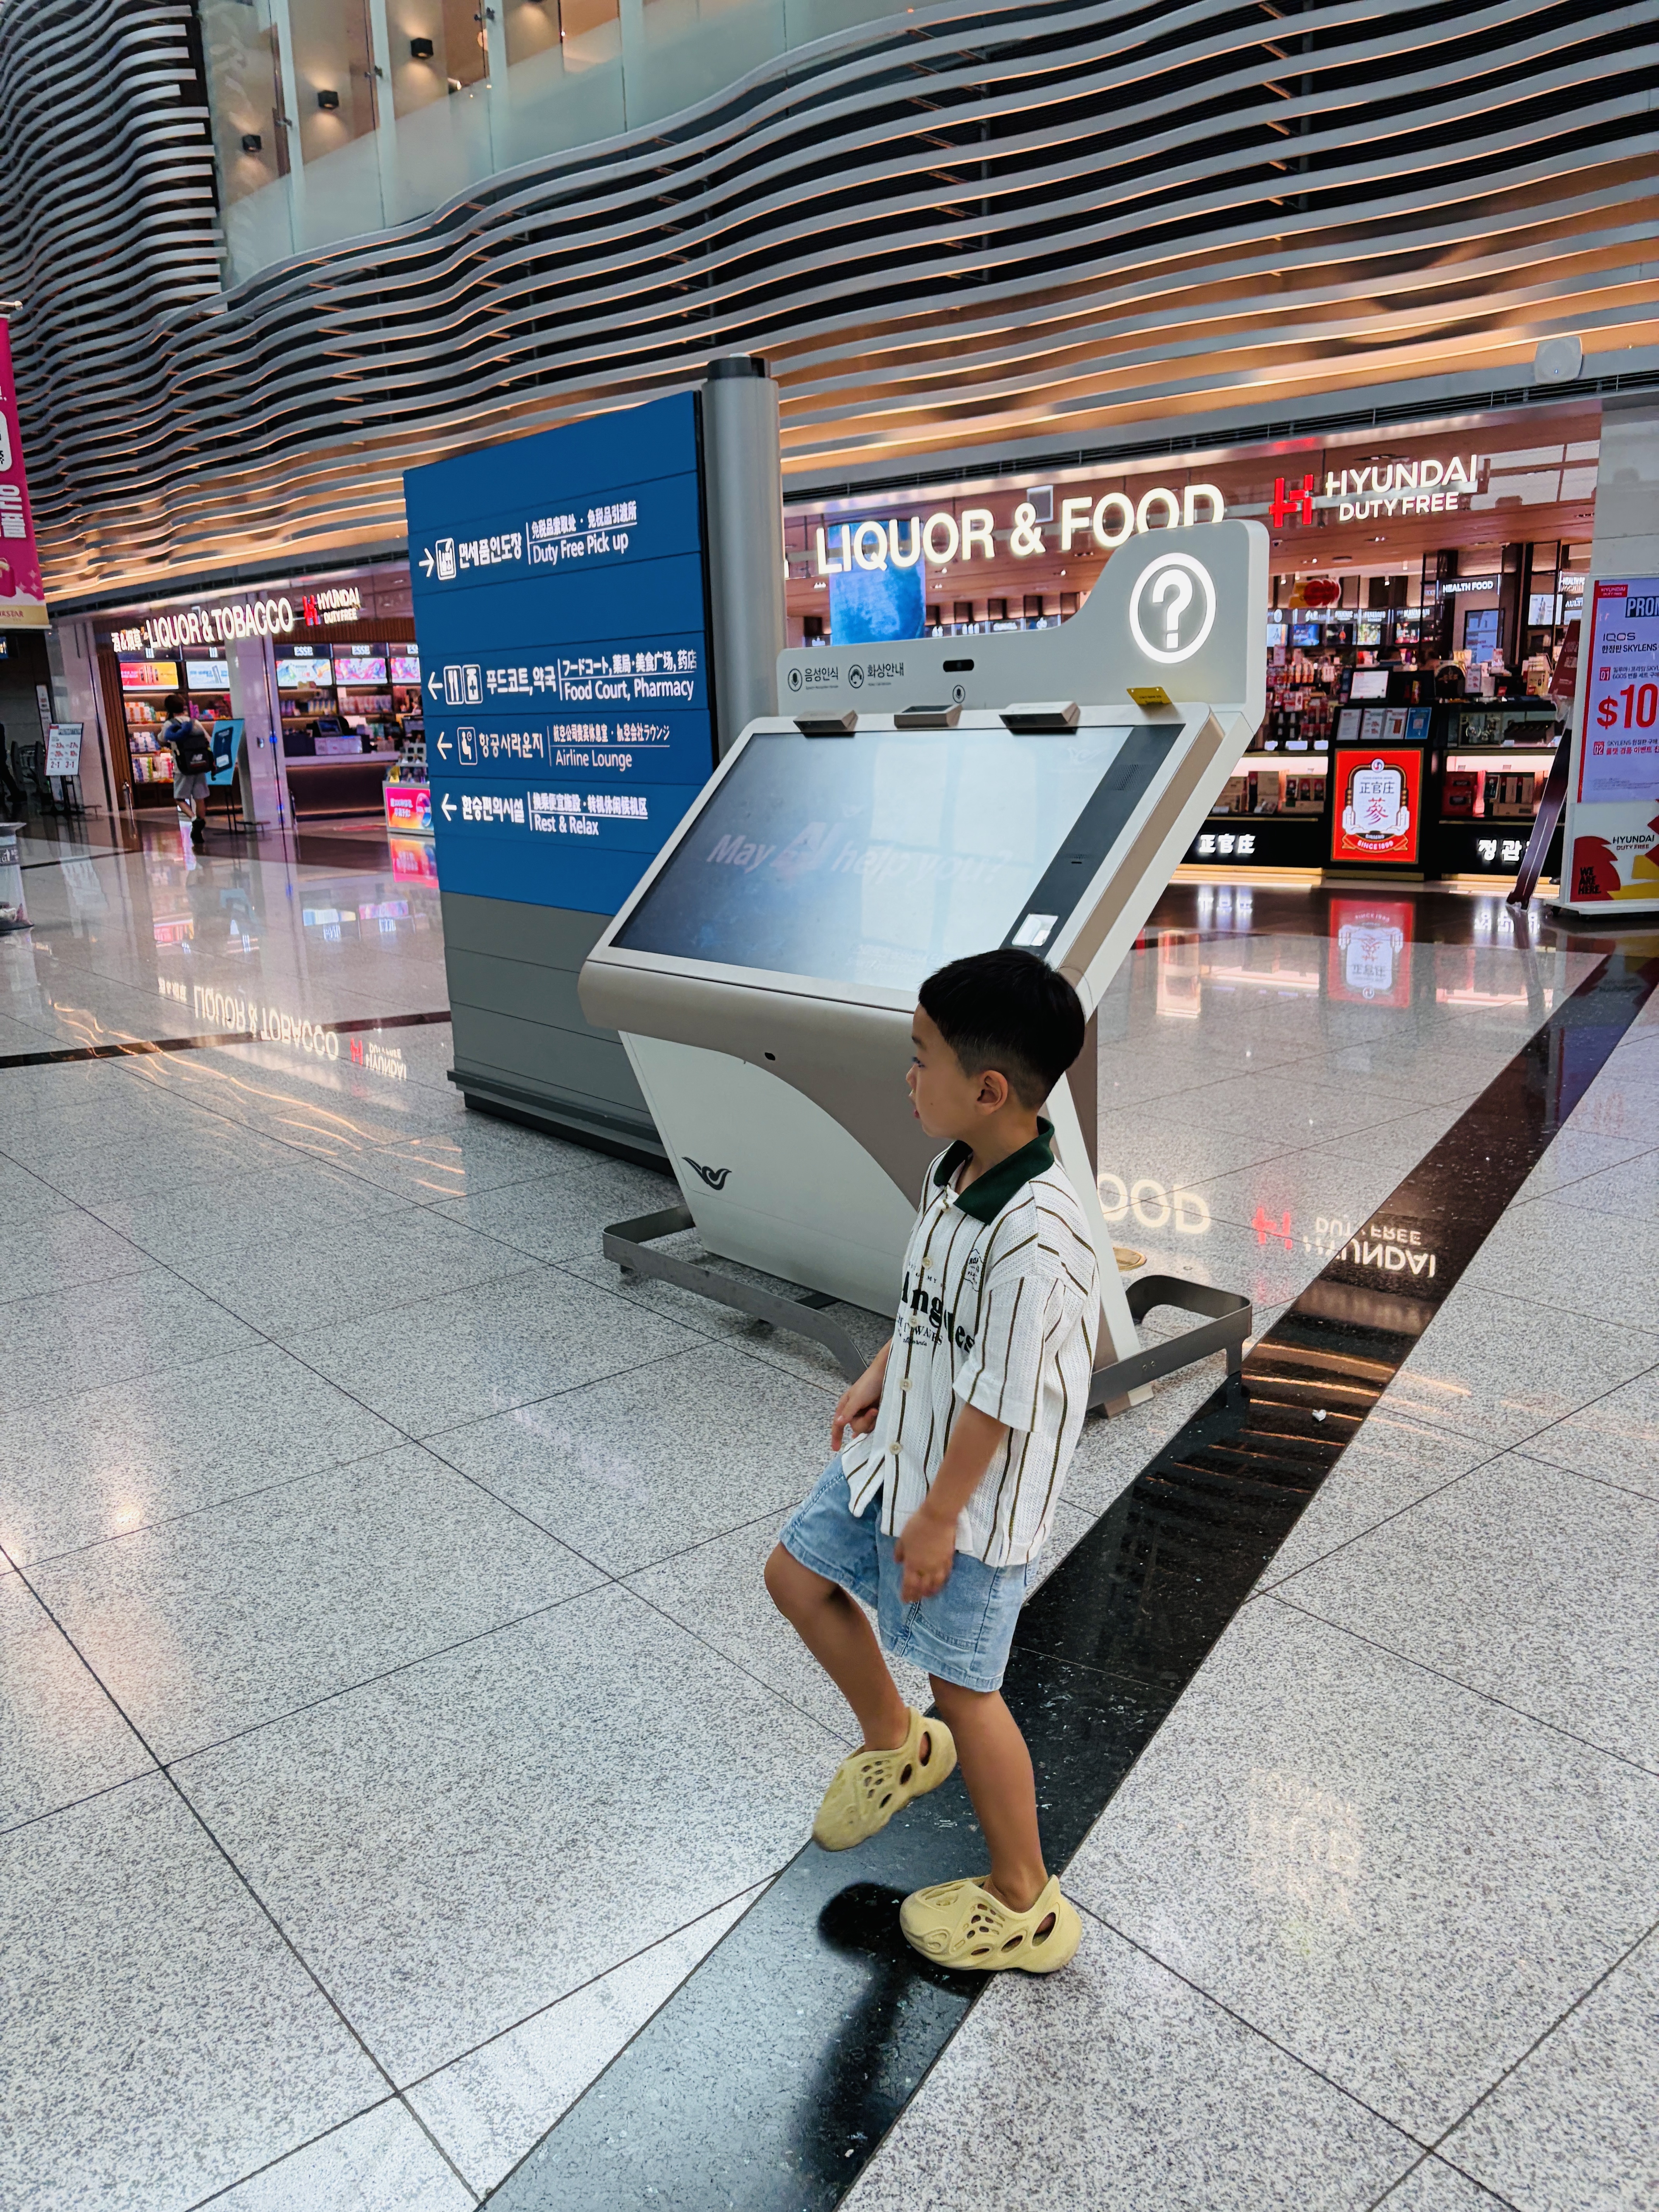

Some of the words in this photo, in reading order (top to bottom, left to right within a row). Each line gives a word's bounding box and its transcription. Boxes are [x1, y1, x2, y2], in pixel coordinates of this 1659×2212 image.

[1326, 455, 1477, 498] HYUNDAI
[1339, 498, 1398, 521] DUTY
[1401, 491, 1459, 515] FREE
[816, 508, 995, 575] LIQUOR
[1010, 502, 1046, 556] &
[1061, 483, 1225, 551] FOOD
[458, 532, 522, 569] 면세품인도장
[533, 543, 558, 566] Duty
[560, 539, 584, 559] Free
[587, 531, 610, 555] Pick
[612, 532, 629, 554] up
[1443, 582, 1471, 593] HEALTH
[1472, 580, 1494, 591] FOOD
[316, 587, 360, 610] HYUNDAI
[146, 613, 201, 649] LIQUOR
[201, 610, 215, 642] &
[211, 597, 294, 640] TOBACCO
[323, 610, 340, 624] DUTY
[340, 608, 358, 621] FREE
[1603, 632, 1636, 642] IQOS
[1623, 643, 1657, 652] SKYLENS
[294, 646, 313, 656] ESSE
[351, 645, 371, 655] ESSE
[804, 666, 839, 682] 음성인식
[867, 662, 905, 678] 화상안내
[564, 680, 592, 701] Food
[595, 680, 631, 701] Court,
[634, 676, 695, 702] Pharmacy
[479, 732, 544, 759] 항공사라운지
[556, 749, 589, 767] Airline
[592, 749, 632, 772] Lounge
[1359, 781, 1395, 794] 正官庄
[462, 795, 525, 824] 환승편의시설
[534, 814, 556, 833] Rest
[559, 815, 567, 833] &
[569, 816, 599, 836] Relax
[1199, 833, 1256, 854] 正官庄
[1357, 840, 1377, 850] SINCE
[1478, 838, 1530, 862] 정관
[1613, 835, 1655, 844] HYUNDAI
[706, 834, 777, 874] May
[1580, 866, 1594, 876] WE
